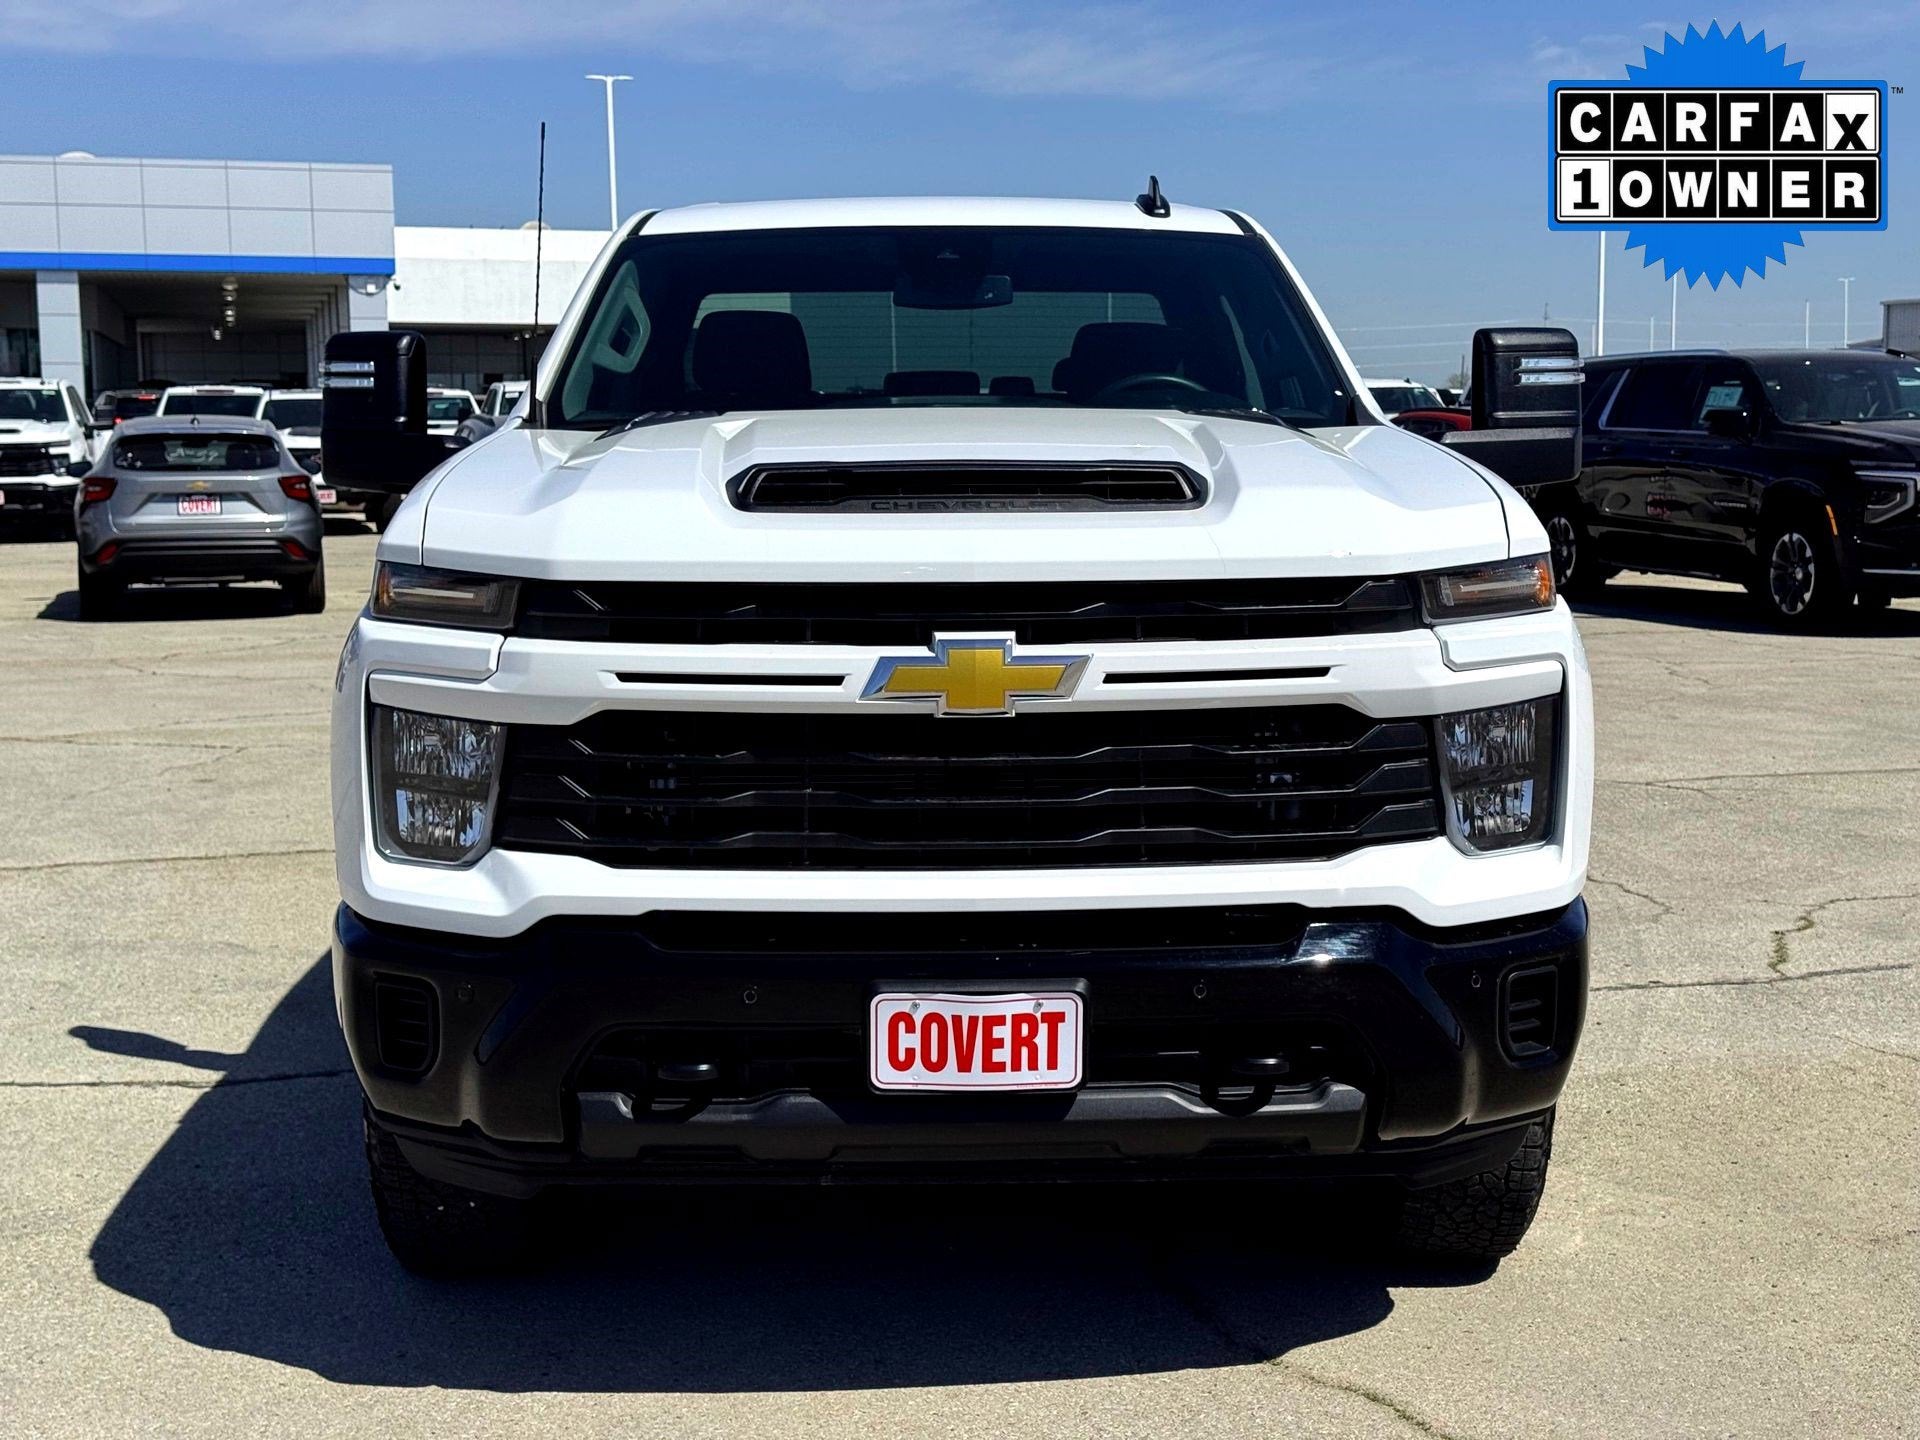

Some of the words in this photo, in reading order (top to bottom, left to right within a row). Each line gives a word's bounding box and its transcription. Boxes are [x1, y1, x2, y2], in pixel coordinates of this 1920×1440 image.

[181, 498, 217, 513] COVERT
[870, 501, 1072, 511] CHEVROLET
[887, 1011, 1066, 1073] COVERT
